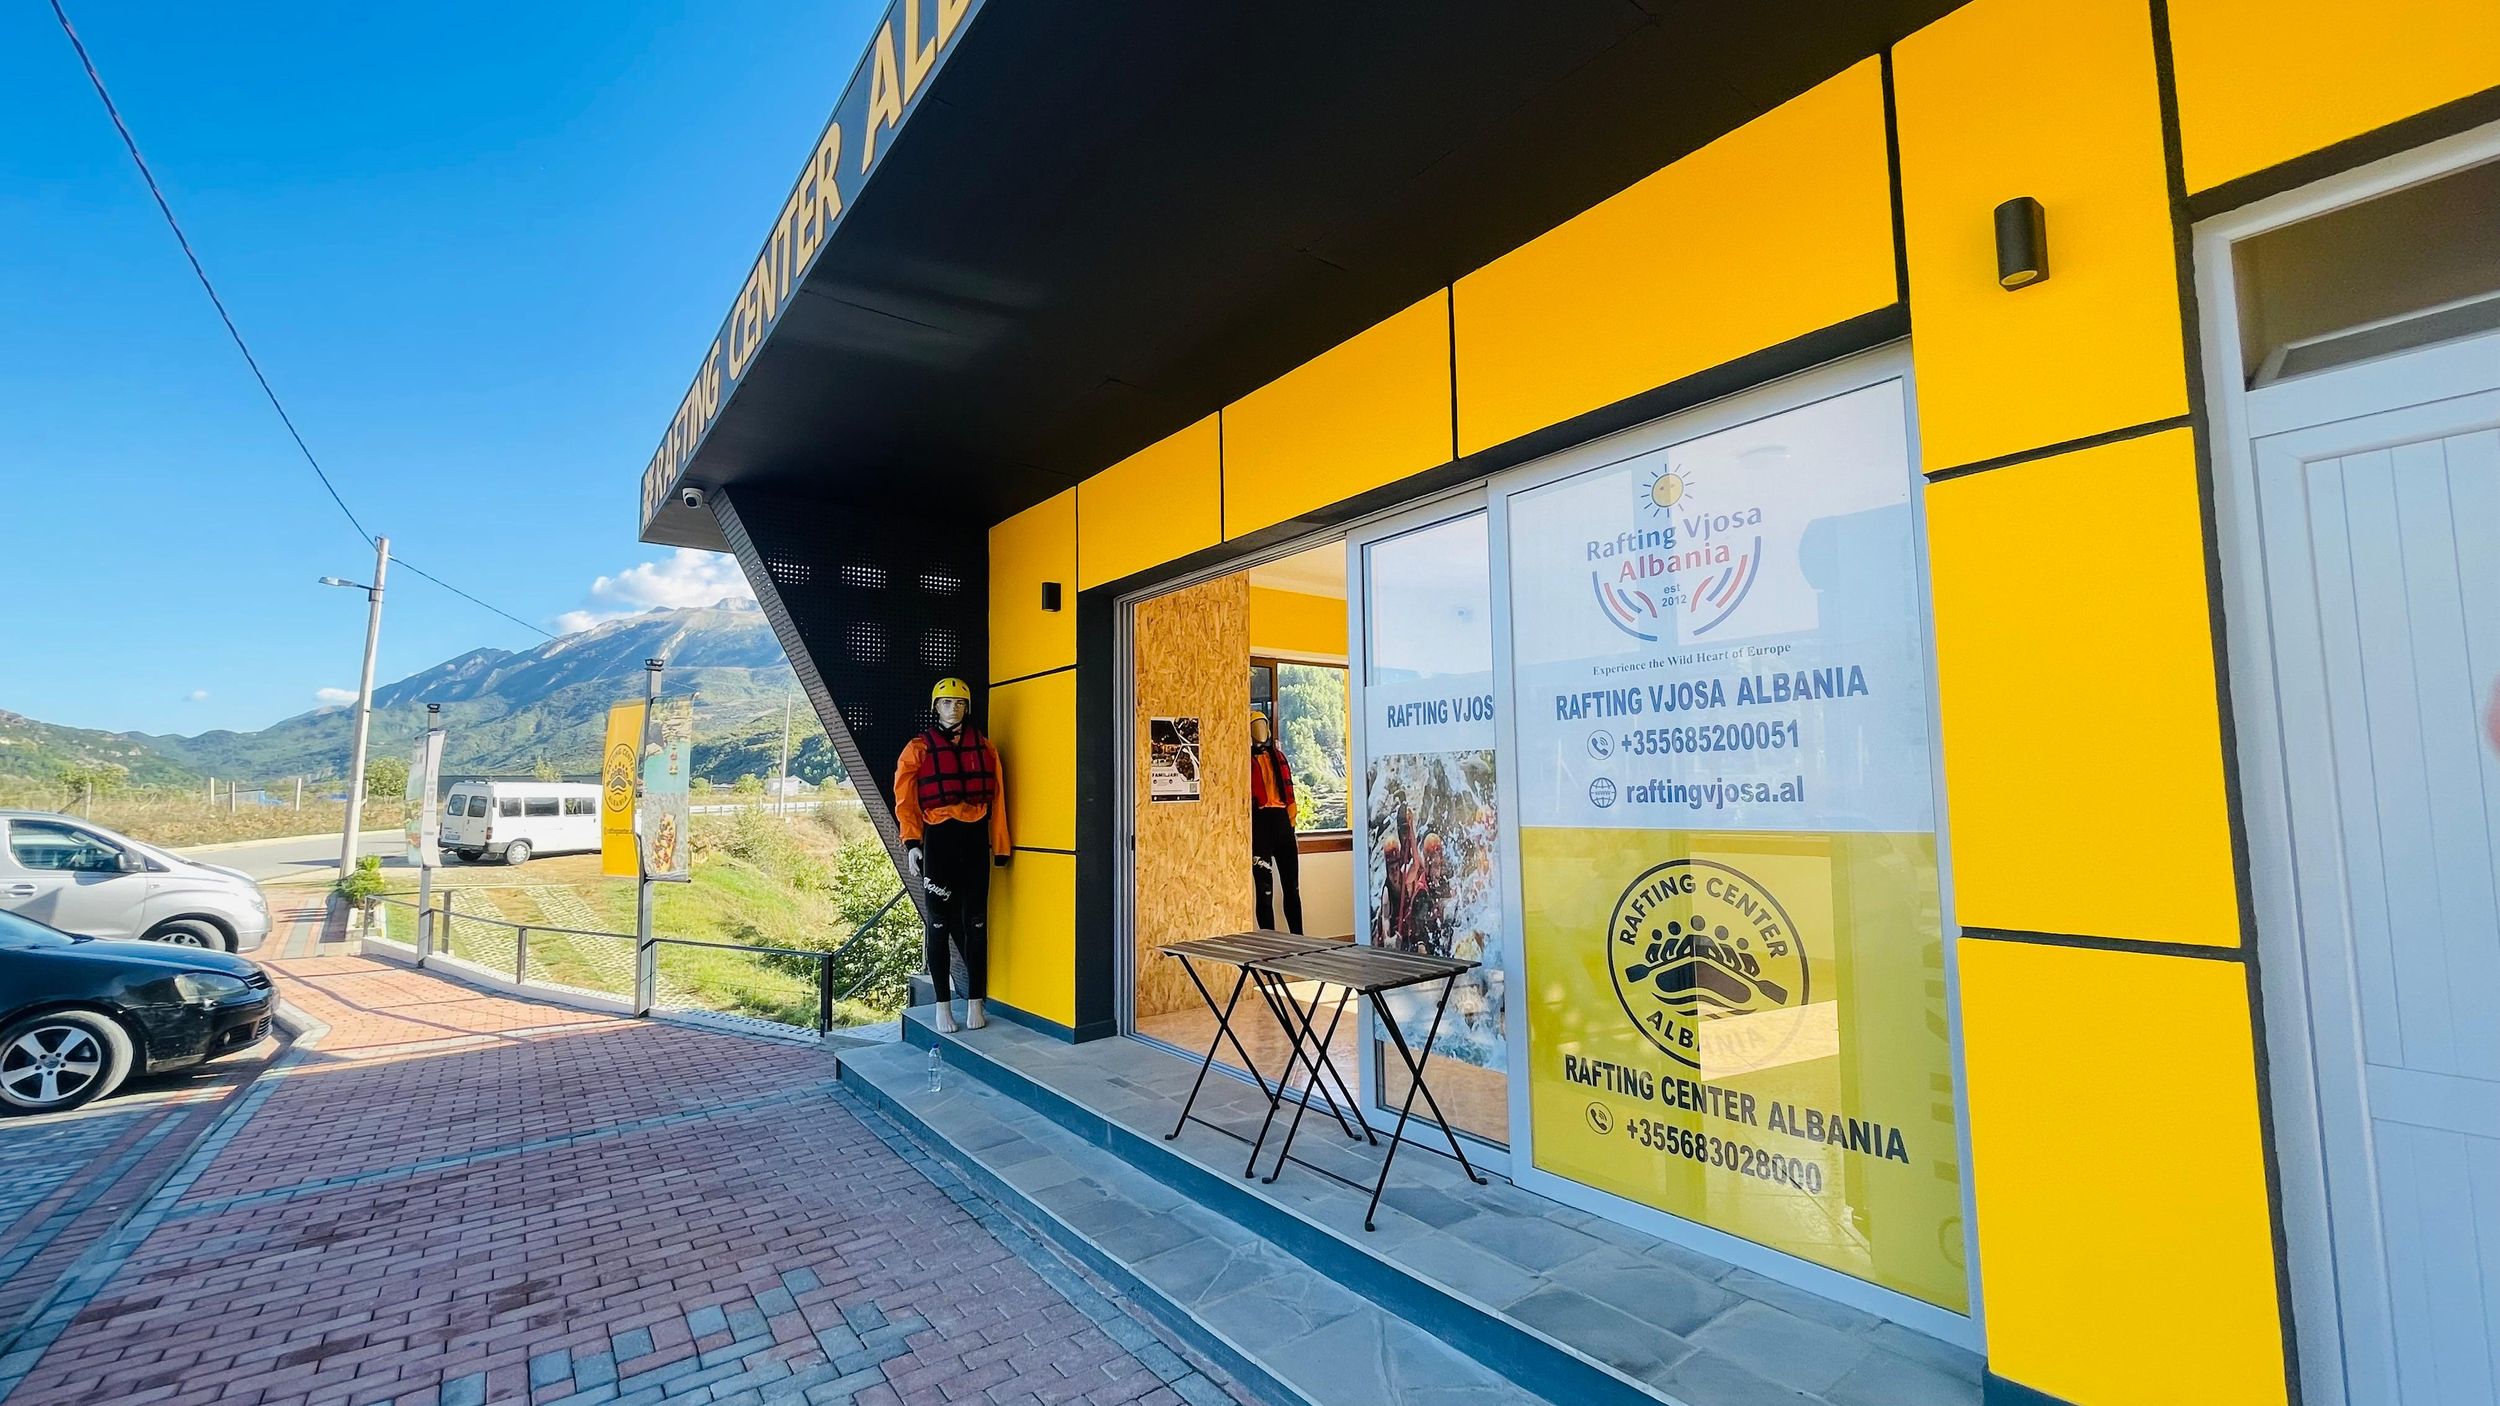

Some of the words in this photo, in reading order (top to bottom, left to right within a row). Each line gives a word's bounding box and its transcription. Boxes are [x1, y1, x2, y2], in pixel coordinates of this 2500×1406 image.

[654, 338, 720, 507] RAFTING
[728, 121, 843, 381] CENTER
[1587, 527, 1677, 561] Rafting
[1683, 507, 1762, 541] Vjosa
[1619, 542, 1730, 583] Albania
[1661, 594, 1687, 607] 2012
[1663, 583, 1681, 594] est
[1593, 660, 1646, 676] Experience
[1649, 658, 1664, 668] the
[1667, 653, 1693, 666] Wild
[1696, 650, 1728, 663] Heart
[1732, 647, 1743, 658] of
[1747, 643, 1791, 658] Europe
[1556, 686, 1642, 720] RAFTING
[1648, 678, 1727, 713] VJOSA
[1737, 664, 1869, 706] ALBANIA
[1388, 699, 1448, 728] RAFTING
[1621, 718, 1799, 756] +355685200051
[1626, 775, 1804, 809] raftingvjosa.al
[1619, 873, 1696, 945] RAFTING
[1706, 877, 1788, 958] CENTER
[1565, 1054, 1654, 1101] RAFTING
[1661, 1075, 1757, 1127] CENTER
[1768, 1101, 1909, 1164] ALBANIA
[1627, 1118, 1822, 1195] +355683028000
